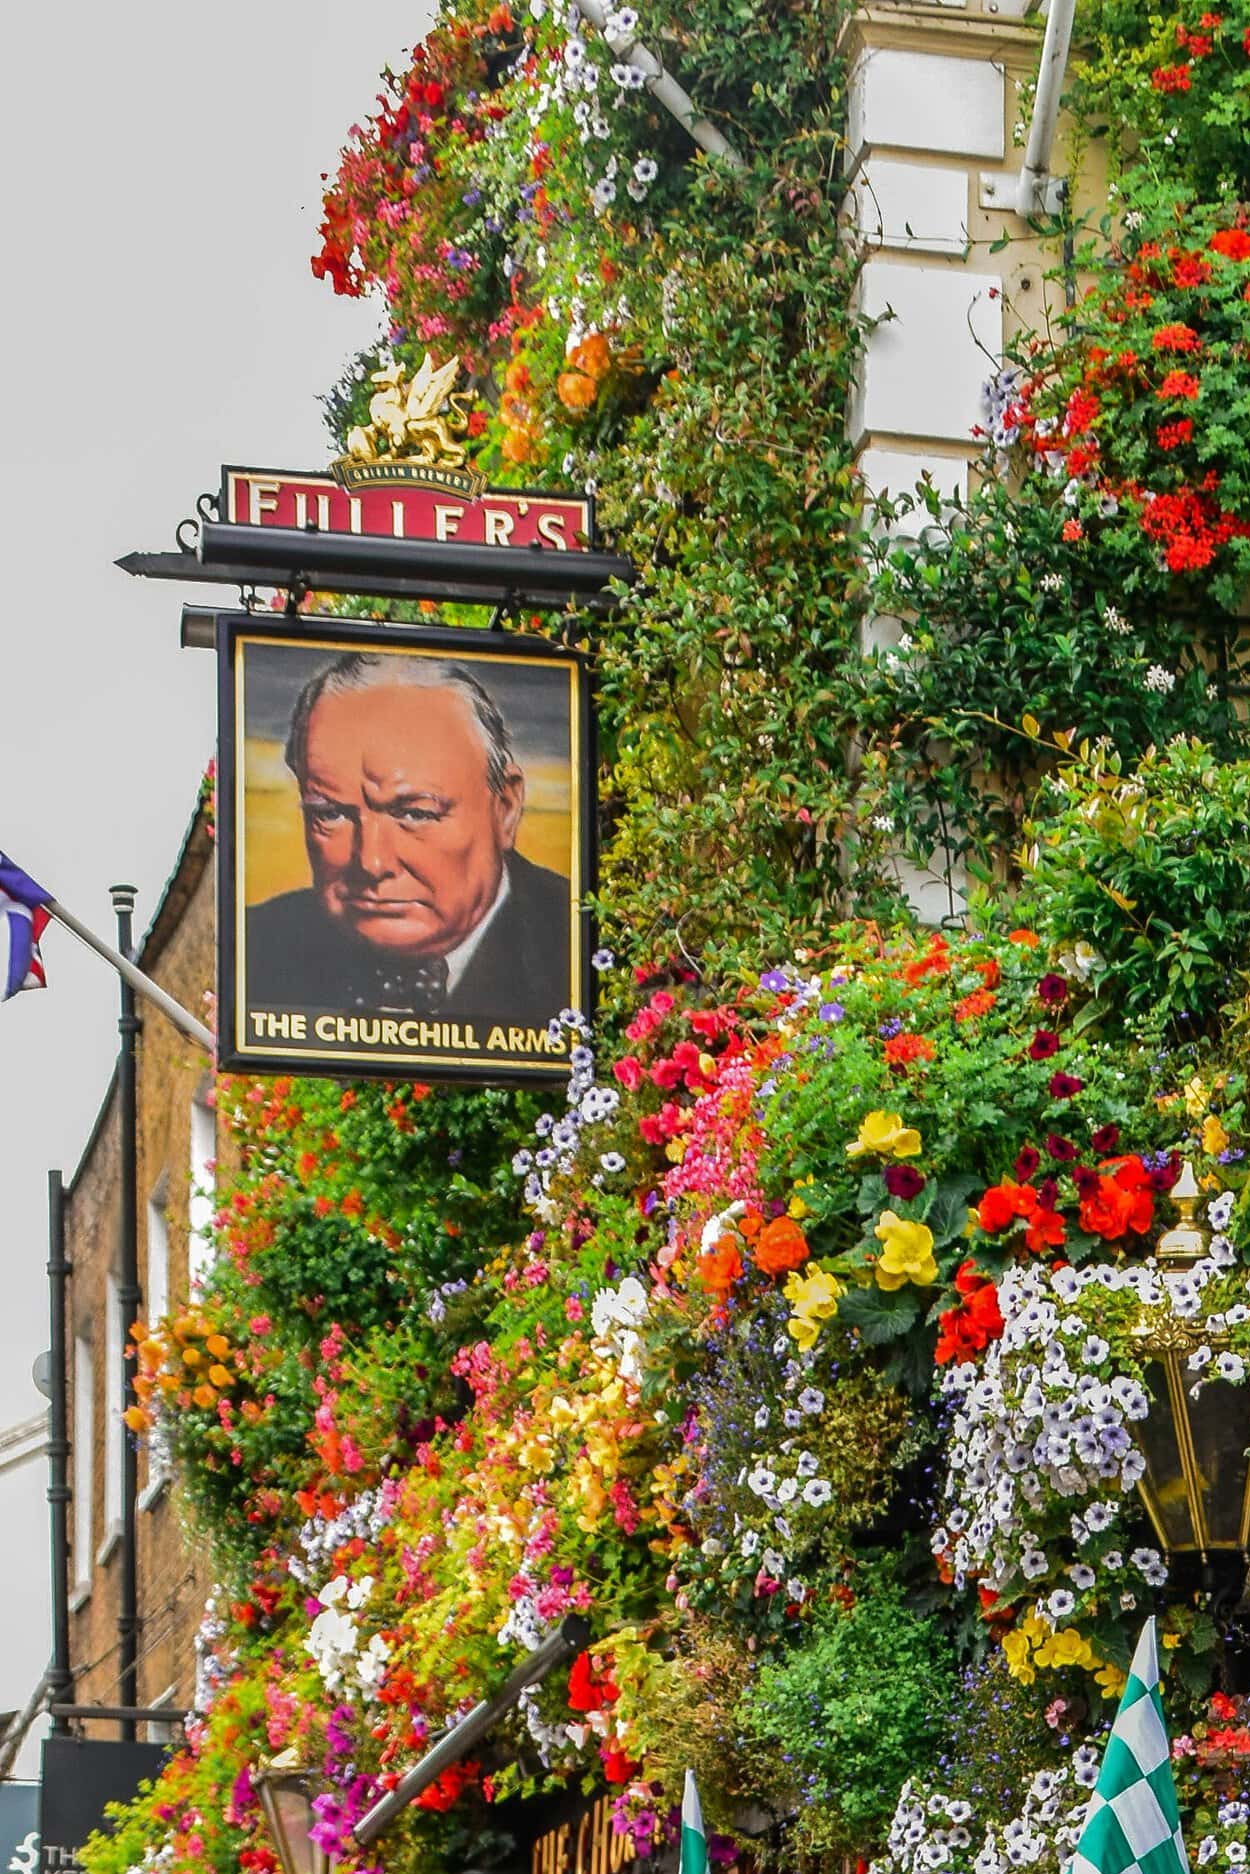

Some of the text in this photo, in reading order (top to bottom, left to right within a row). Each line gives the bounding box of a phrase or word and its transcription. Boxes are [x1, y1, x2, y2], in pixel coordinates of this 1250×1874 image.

[250, 1011, 307, 1040] THE
[314, 1015, 480, 1050] CHURCHILL
[42, 1846, 78, 1866] TH
